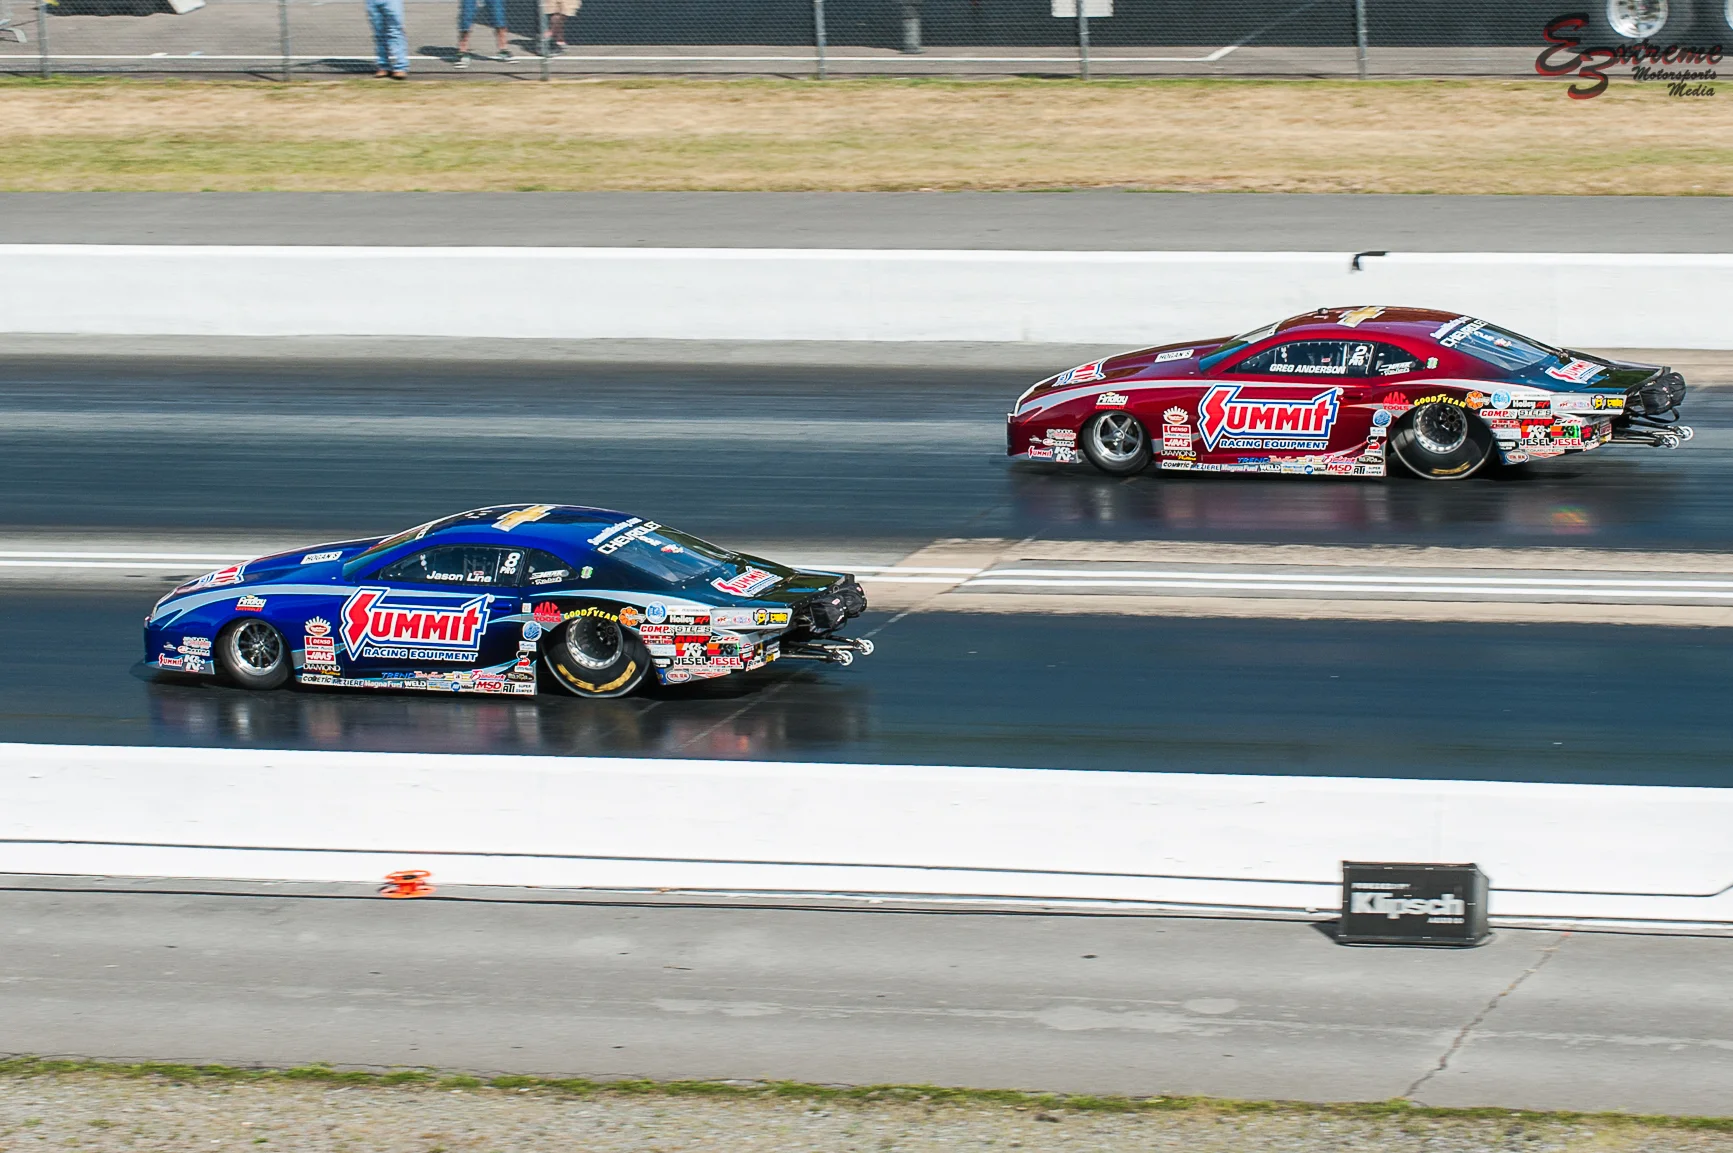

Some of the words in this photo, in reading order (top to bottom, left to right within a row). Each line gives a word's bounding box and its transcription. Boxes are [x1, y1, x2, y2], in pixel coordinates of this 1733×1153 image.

[1355, 346, 1369, 358] 2
[1269, 363, 1294, 373] GREG
[1295, 365, 1347, 375] ANDERSON
[1383, 391, 1409, 405] MAC
[1414, 393, 1467, 409] GOODYEAR
[1168, 439, 1190, 447] HAAS
[1220, 440, 1262, 450] RACING
[1264, 440, 1328, 451] EQUIPMENT
[1519, 438, 1551, 446] JESEL
[1552, 438, 1582, 446] JESEL
[1328, 463, 1352, 472] MSD
[504, 552, 521, 567] 8
[500, 566, 516, 575] PRO
[426, 570, 463, 582] Jason
[466, 571, 492, 583] Line
[534, 601, 561, 616] MAC
[564, 606, 619, 622] GOODYEAR
[670, 615, 694, 625] Holley
[311, 651, 333, 660] HAAS
[364, 648, 407, 658] RACING
[410, 651, 477, 662] EQUIPMENT
[674, 657, 707, 666] JESEL
[709, 657, 741, 666] JESEL
[302, 663, 341, 672] DIAMOND
[404, 680, 427, 688] WELD
[476, 681, 502, 690] MSD
[503, 682, 515, 692] ATI
[1351, 892, 1465, 919] Klipsch
